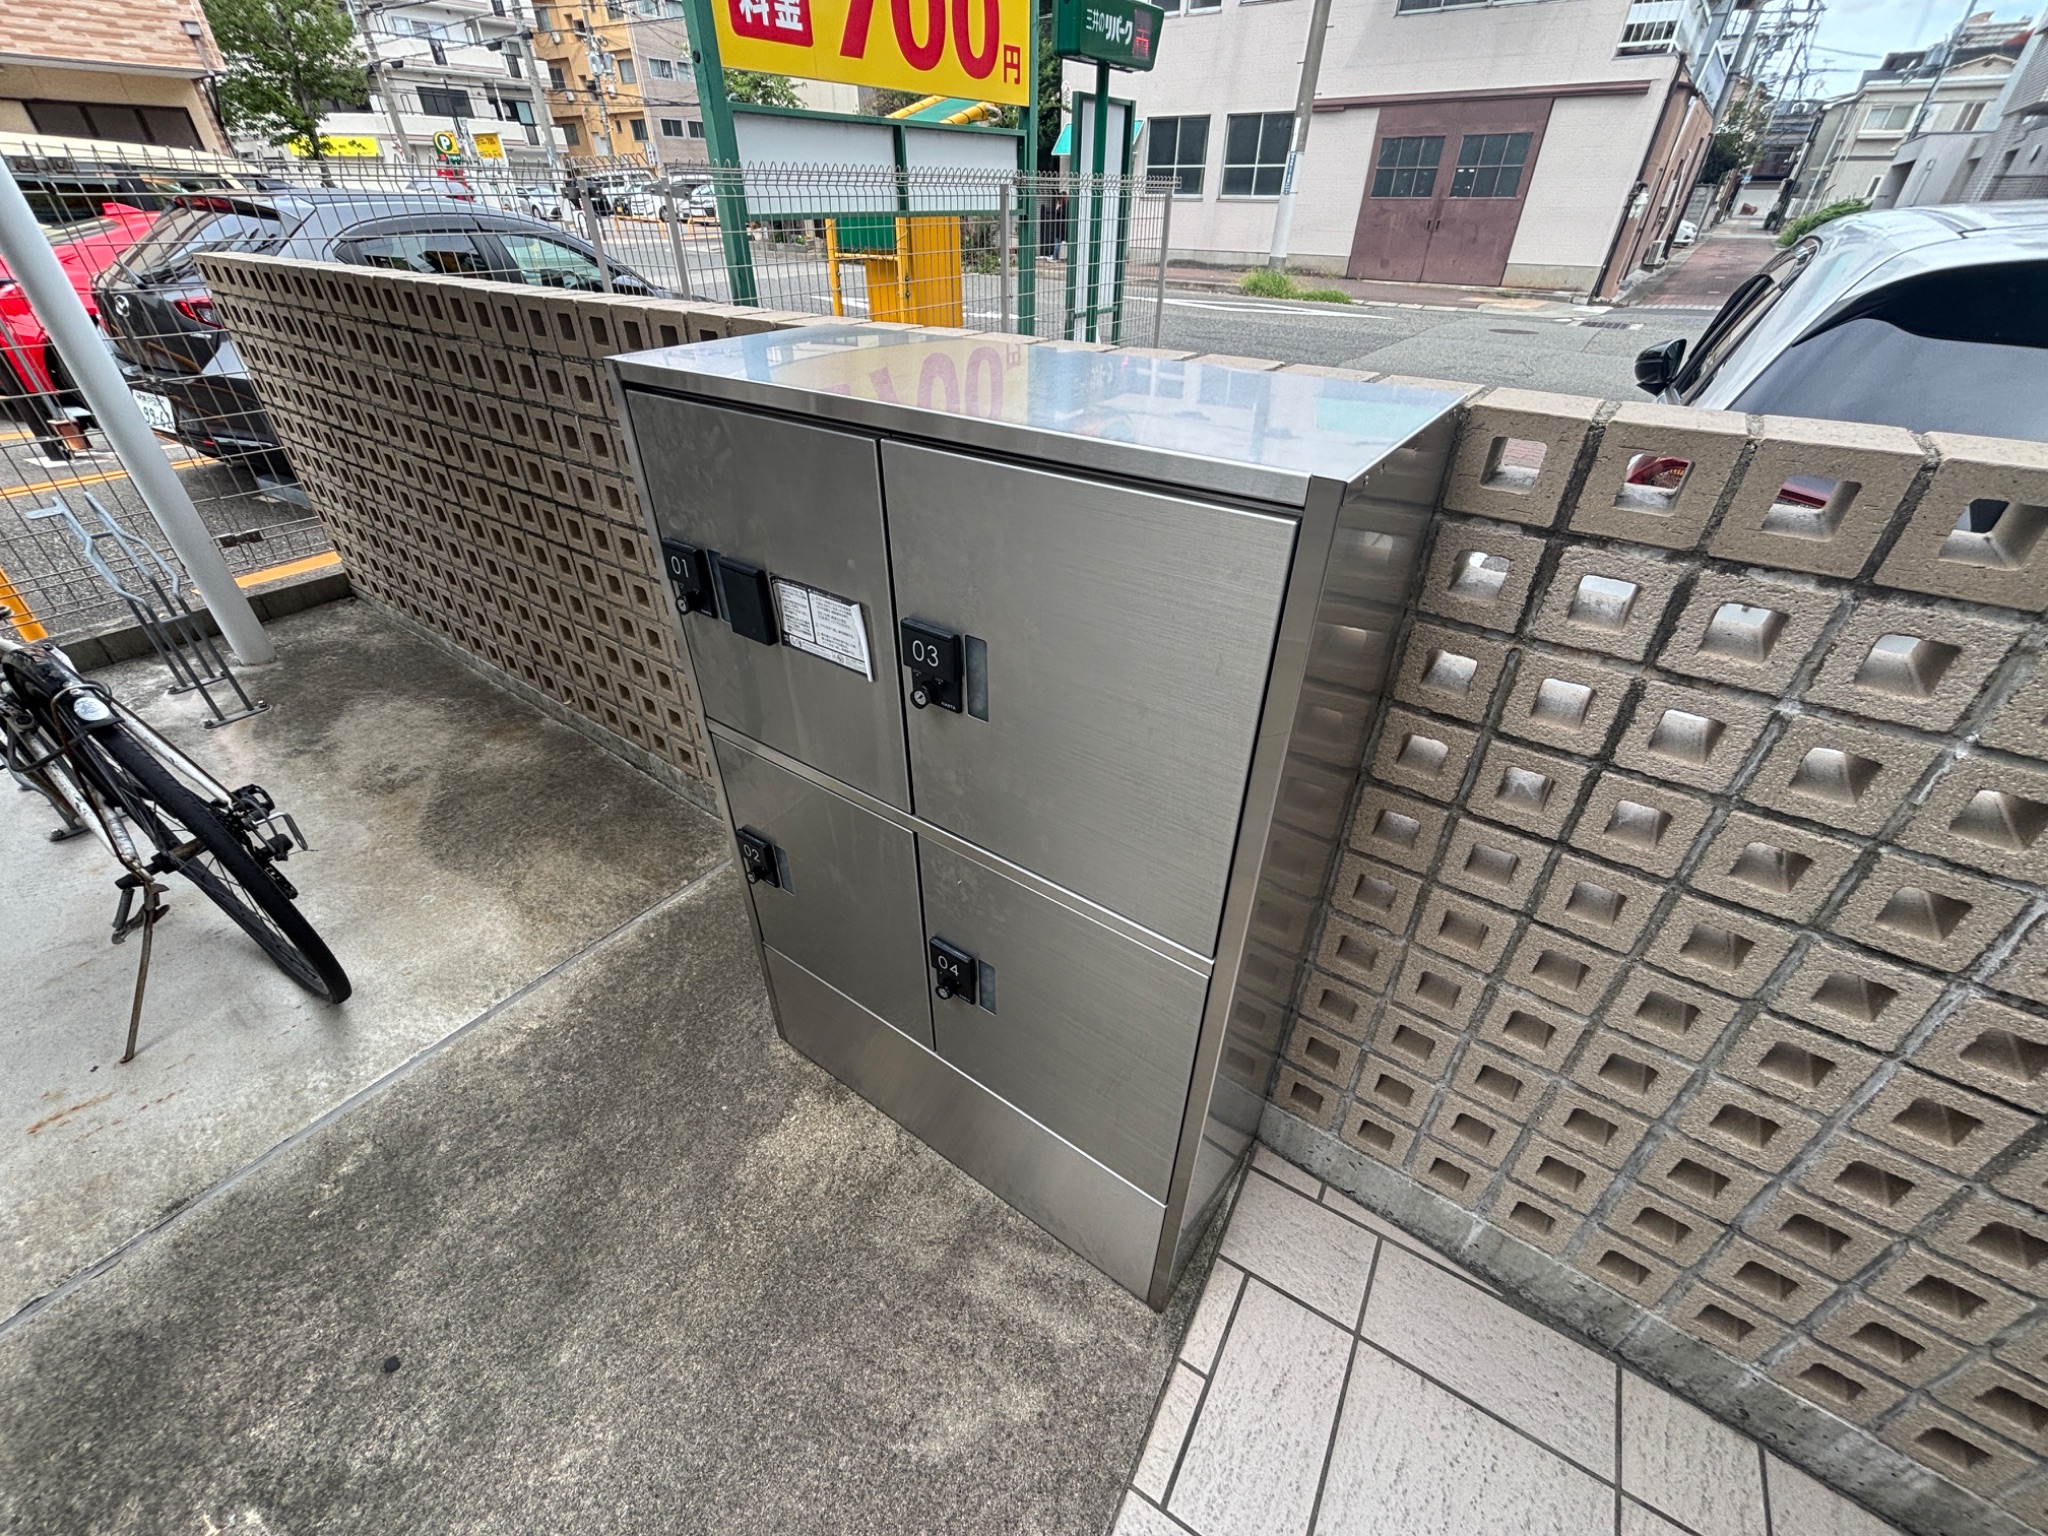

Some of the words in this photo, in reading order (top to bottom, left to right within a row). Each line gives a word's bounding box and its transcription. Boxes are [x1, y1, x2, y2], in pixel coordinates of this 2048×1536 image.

[1085, 8, 1134, 46] 三井のリパーク
[670, 555, 690, 578] 01
[912, 639, 939, 668] 03
[743, 844, 761, 863] 02
[937, 955, 960, 977] 04
